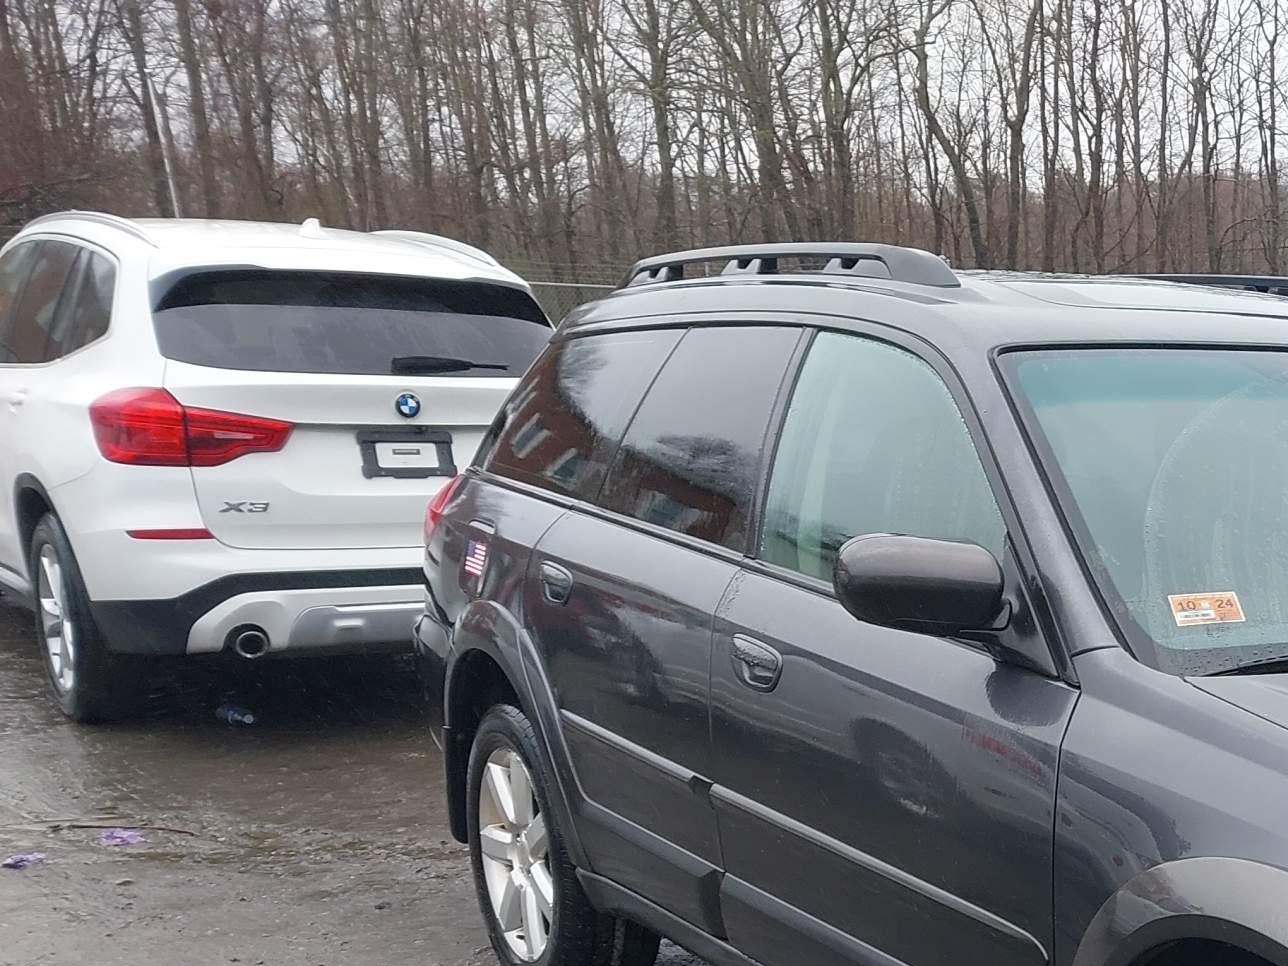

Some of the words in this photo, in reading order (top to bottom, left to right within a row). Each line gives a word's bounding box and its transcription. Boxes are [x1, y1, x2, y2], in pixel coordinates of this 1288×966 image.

[218, 501, 270, 513] X3
[1177, 600, 1196, 611] 10
[1215, 598, 1234, 609] 24
